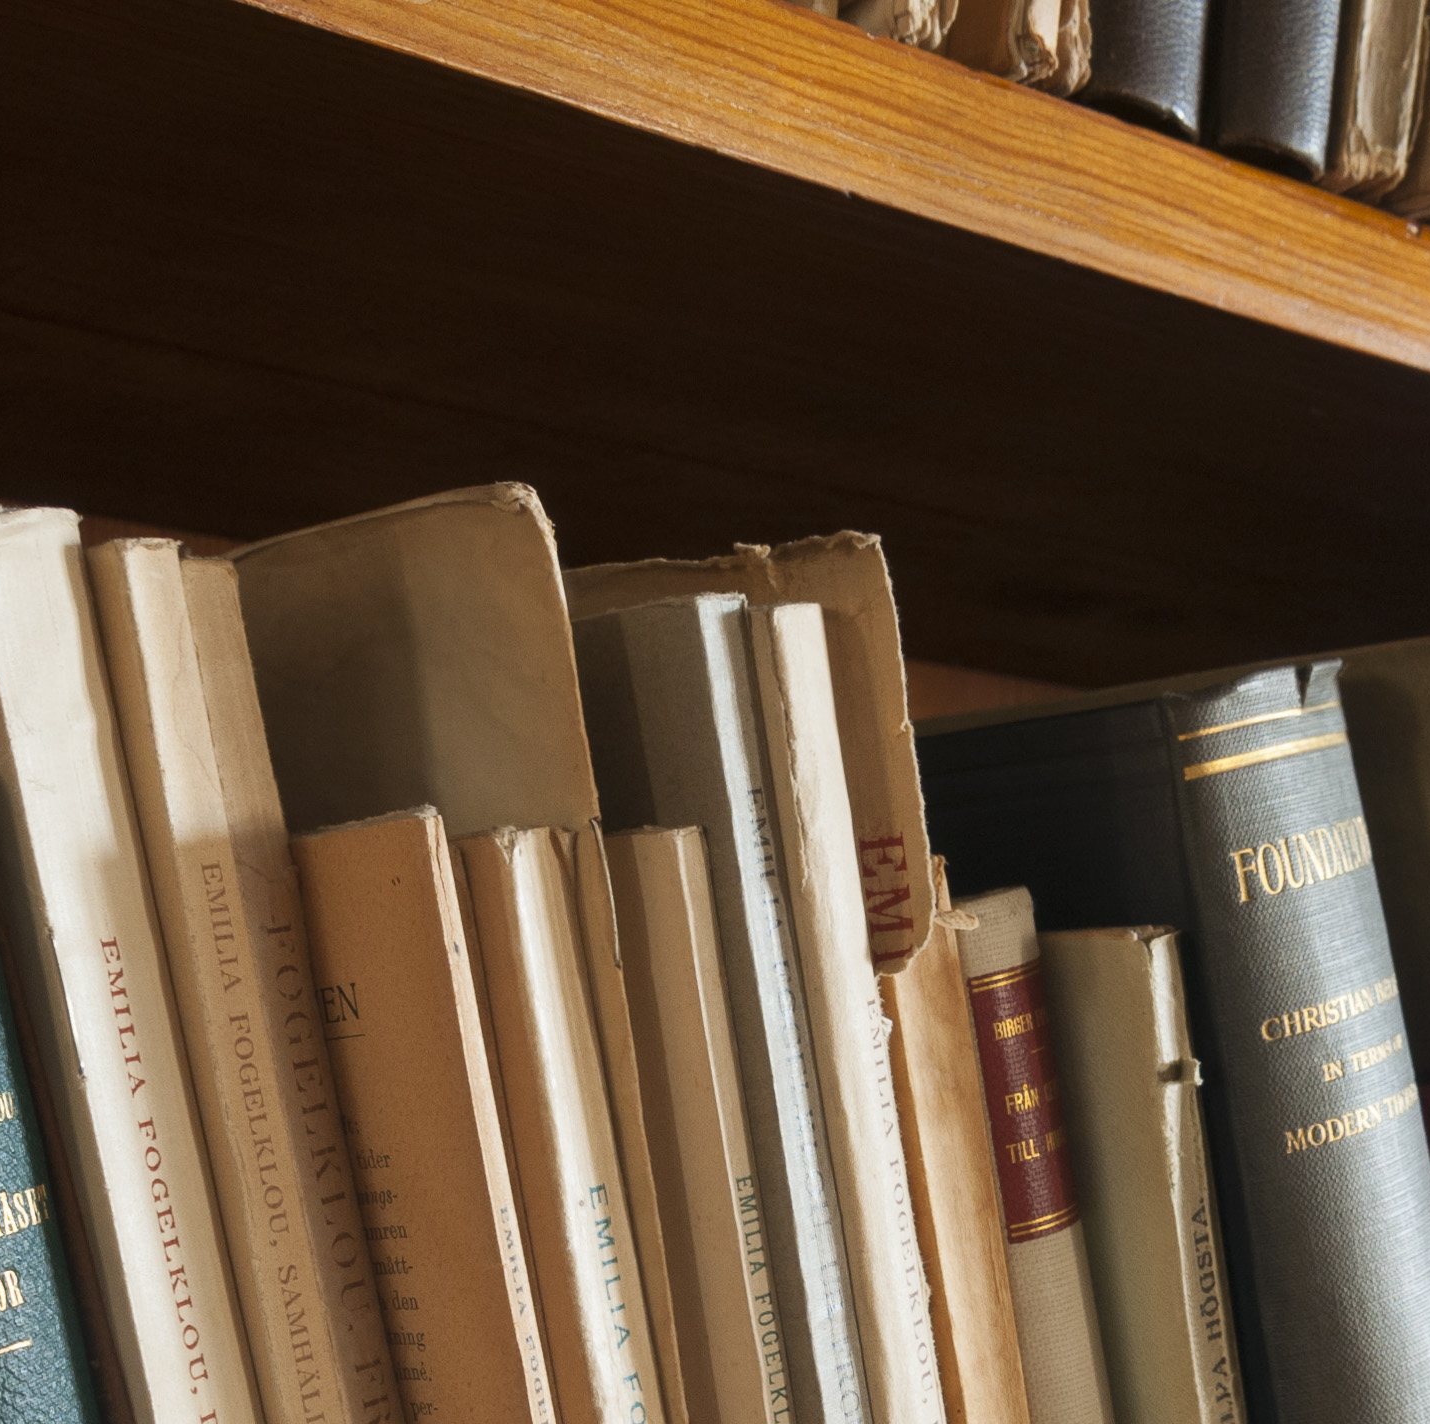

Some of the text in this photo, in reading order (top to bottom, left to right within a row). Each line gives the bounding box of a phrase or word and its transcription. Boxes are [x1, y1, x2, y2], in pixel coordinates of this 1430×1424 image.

[992, 1012, 1035, 1042] BIRGER
[1261, 988, 1375, 1042] CHRISTIAN
[200, 861, 242, 995] EMILIA
[228, 1010, 293, 1249] FOGELKLOU,
[1322, 1058, 1345, 1083] IN
[1004, 1083, 1041, 1116] FRÅN
[1005, 1137, 1042, 1164] TILL
[1284, 1102, 1382, 1156] MODERN
[100, 935, 148, 1099] EMILIA
[137, 1115, 210, 1397] FOGELKLOU,
[735, 1174, 767, 1277] EMILIA
[866, 999, 895, 1144] EMILIA
[888, 1158, 935, 1406] FOGELKLOU,
[500, 1206, 528, 1317] EMILIA
[587, 1182, 632, 1350] EMILIA
[392, 1289, 420, 1311] den
